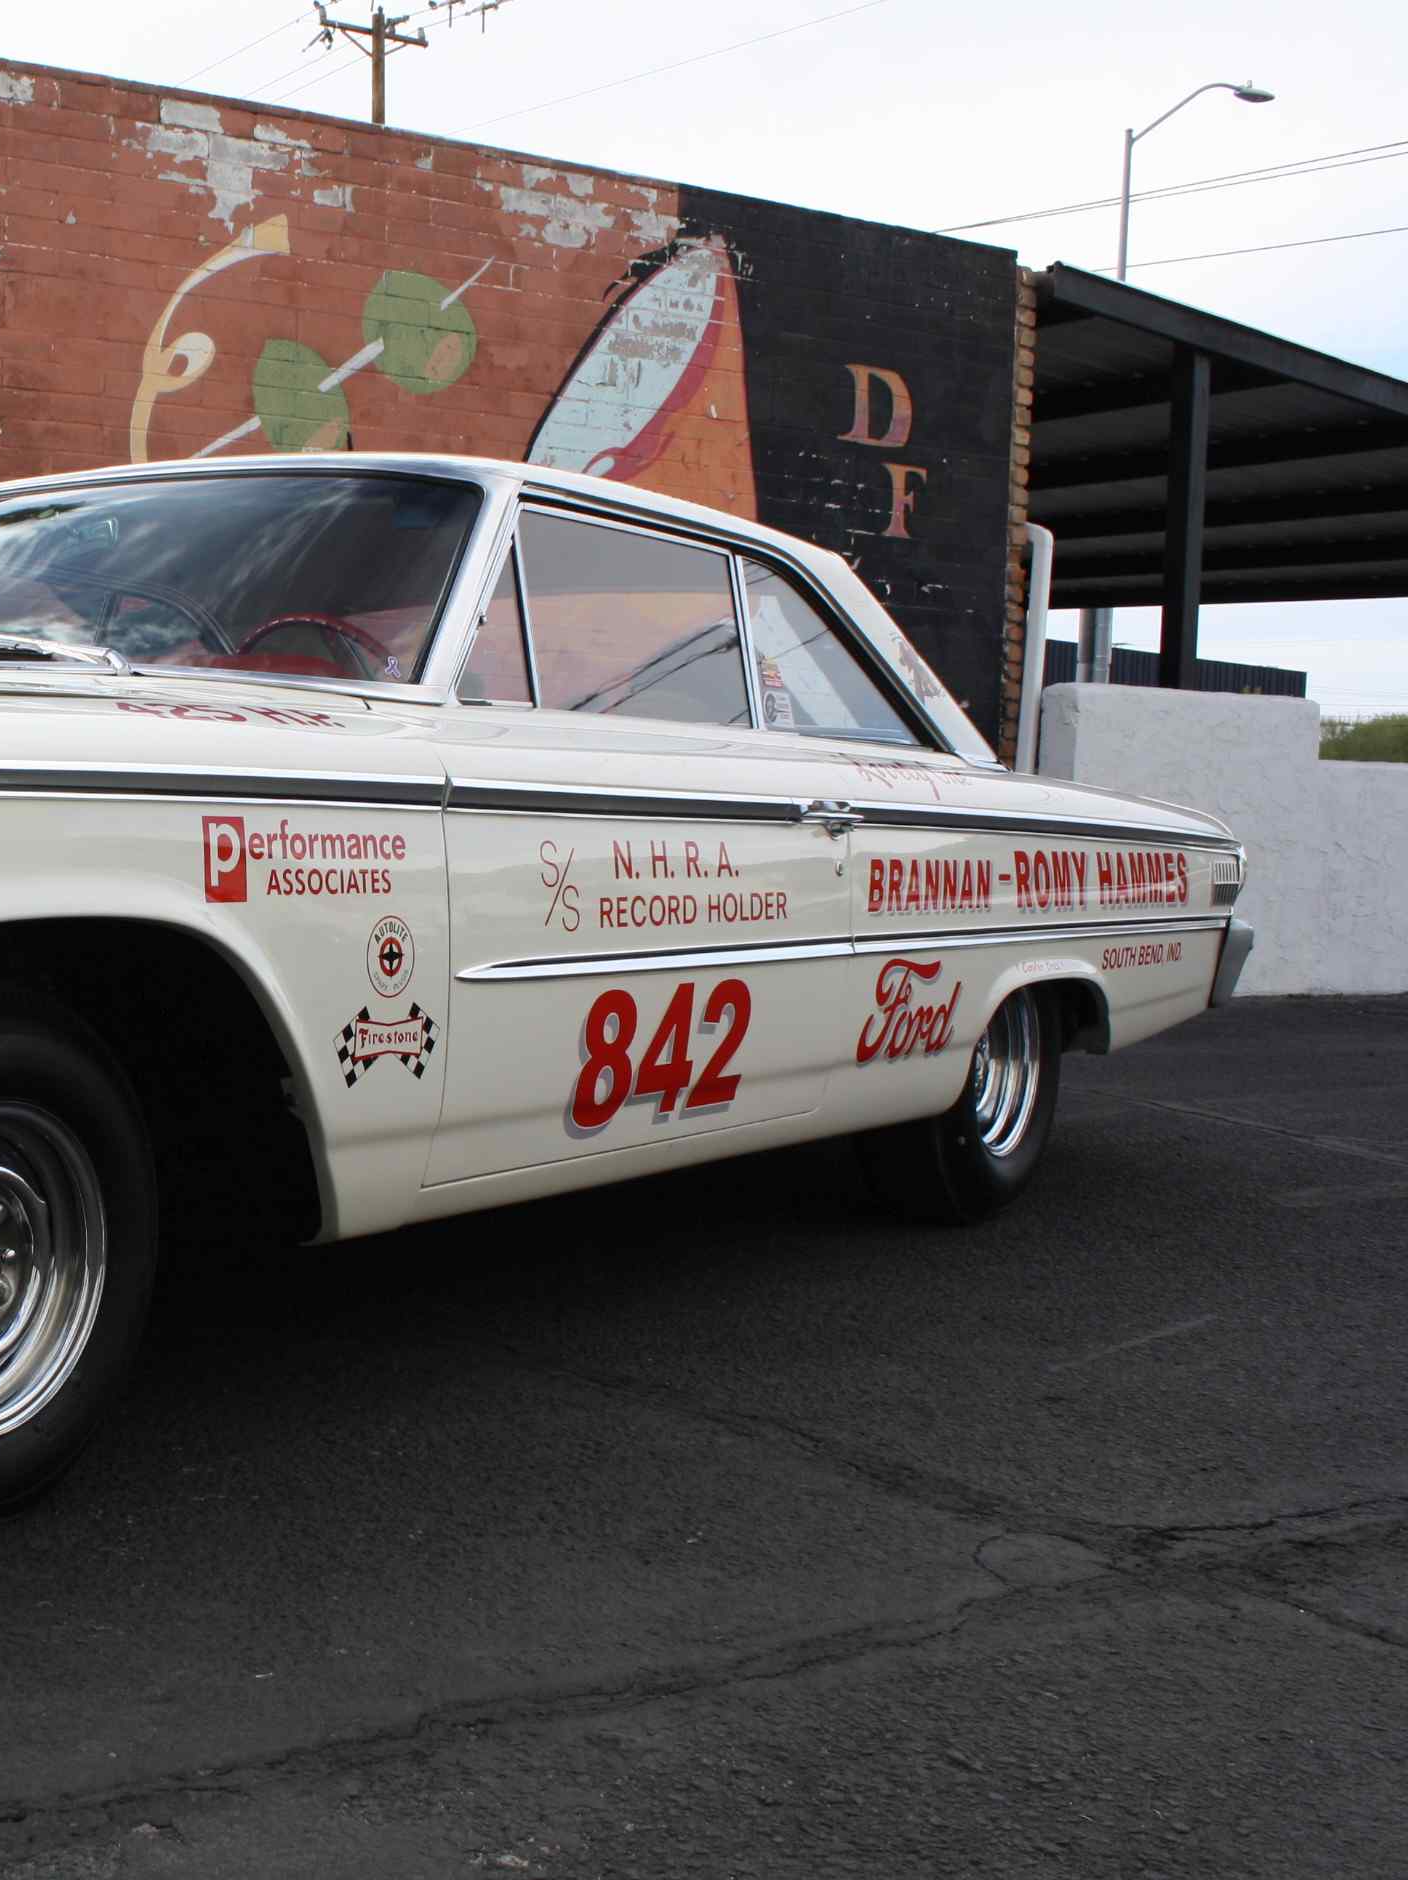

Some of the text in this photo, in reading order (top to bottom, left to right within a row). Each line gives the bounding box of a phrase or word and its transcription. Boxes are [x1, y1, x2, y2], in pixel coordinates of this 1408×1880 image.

[836, 363, 913, 448] D
[880, 462, 928, 540] F
[115, 702, 247, 722] 425
[266, 868, 392, 895] ASSOCIATES
[867, 859, 991, 913] BRANNAN
[1096, 852, 1188, 906] HAMMES
[599, 892, 788, 928] RECORD HOLDER
[374, 921, 409, 944] AUTOLITE
[1102, 946, 1136, 970] SOUTH
[856, 958, 961, 1063] Ford
[359, 1028, 418, 1048] Firestone
[568, 978, 752, 1136] 842
